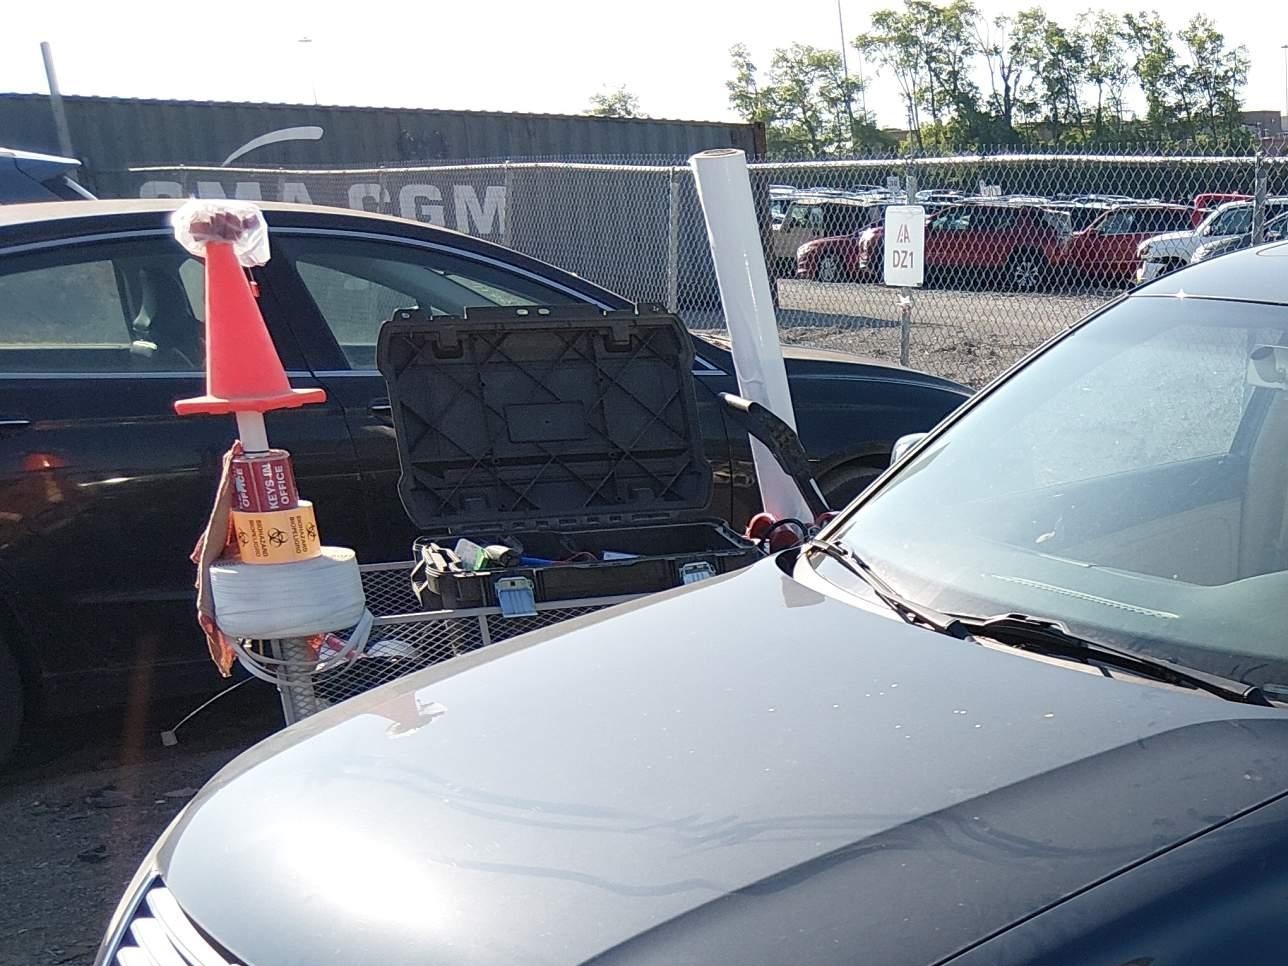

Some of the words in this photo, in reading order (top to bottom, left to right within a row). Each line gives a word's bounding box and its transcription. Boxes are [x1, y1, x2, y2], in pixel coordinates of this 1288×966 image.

[892, 250, 914, 269] DZ1
[265, 478, 280, 509] KEYS
[274, 465, 290, 505] OFFICE
